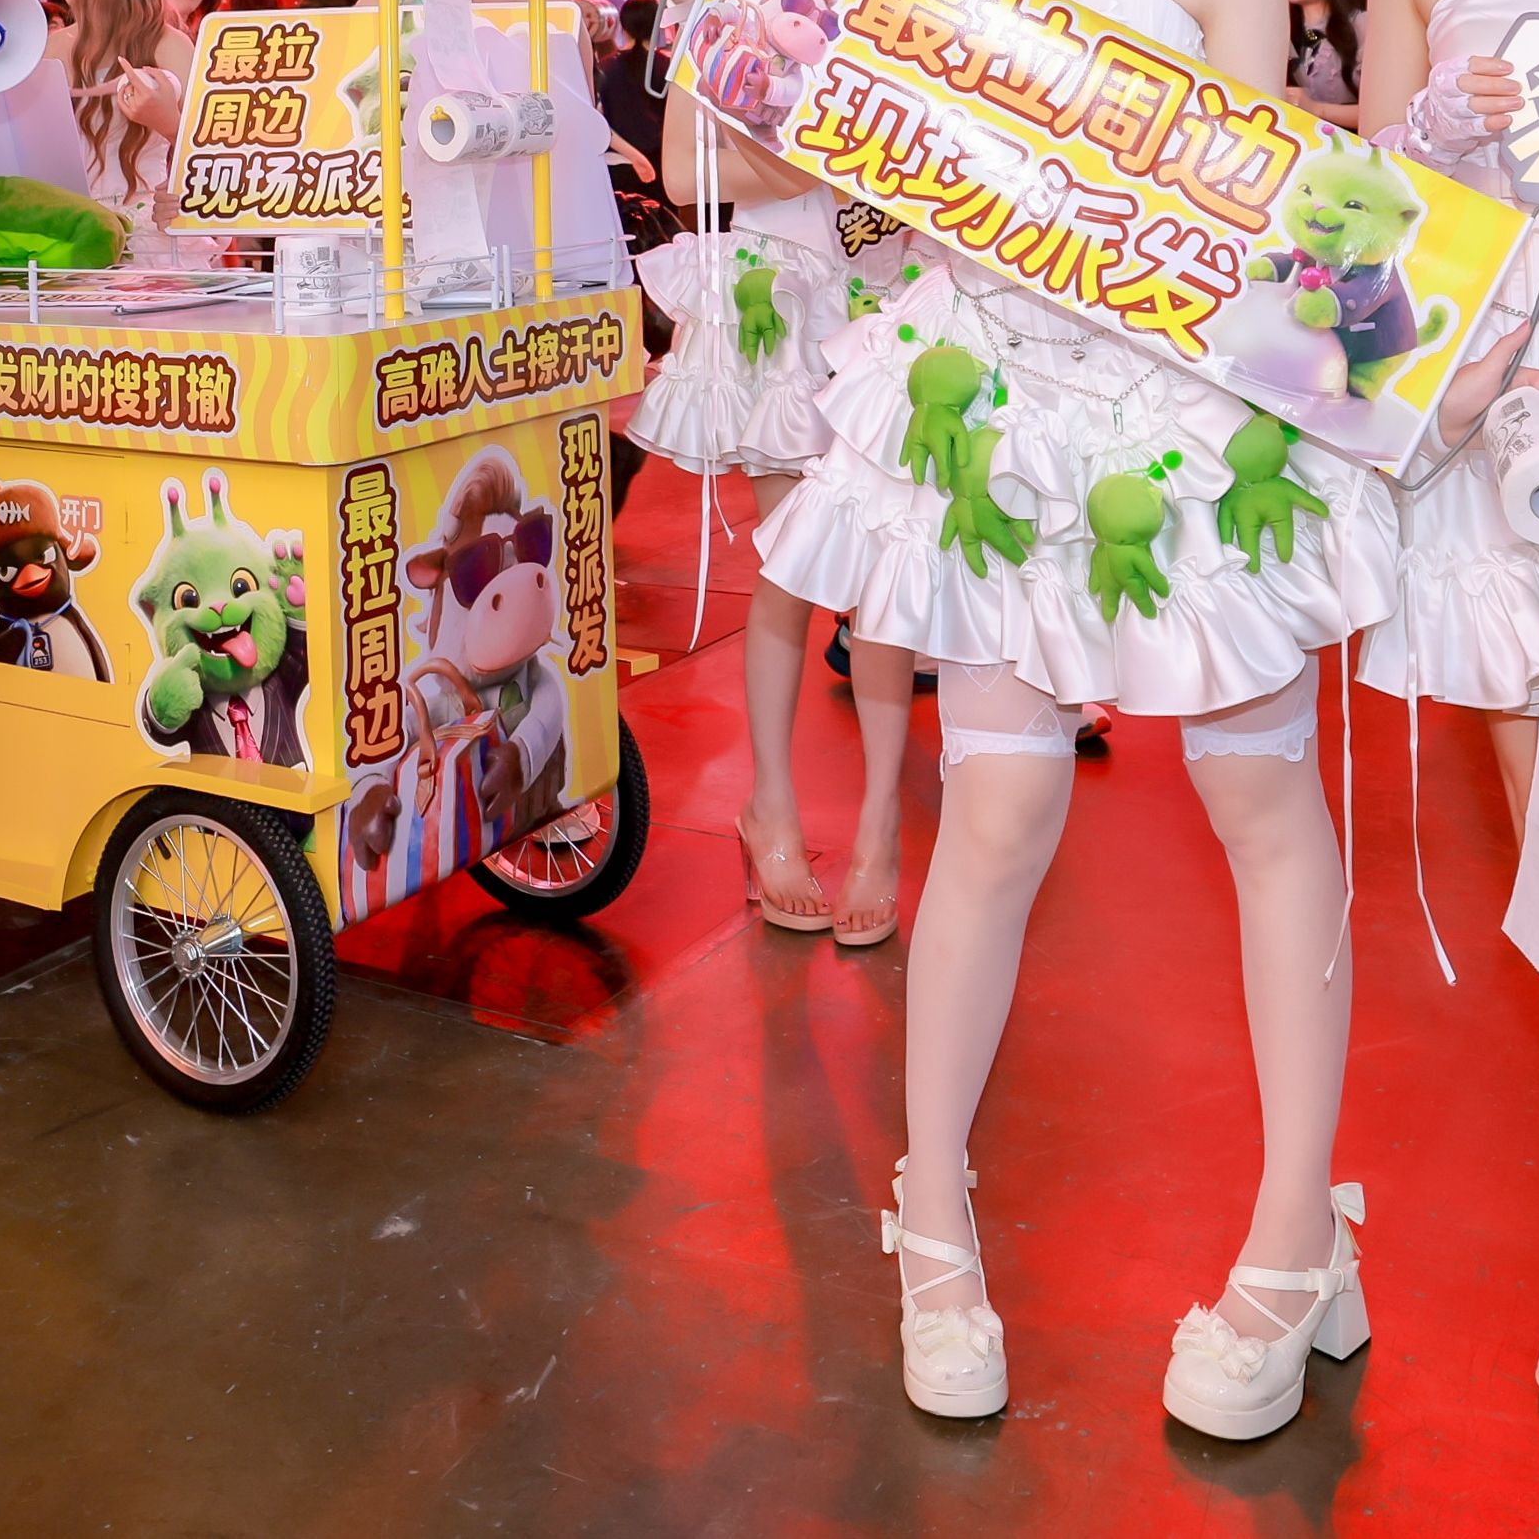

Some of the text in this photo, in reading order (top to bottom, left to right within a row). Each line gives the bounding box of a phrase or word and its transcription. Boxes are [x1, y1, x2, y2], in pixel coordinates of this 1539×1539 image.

[209, 24, 316, 83] 最拉
[197, 90, 305, 147] 周边
[798, 61, 1239, 360] 现场派发
[381, 318, 620, 421] 高雅人士擦汗中
[61, 498, 101, 529] 开门
[563, 419, 604, 669] 现场派发
[345, 470, 401, 761] 最拉周边
